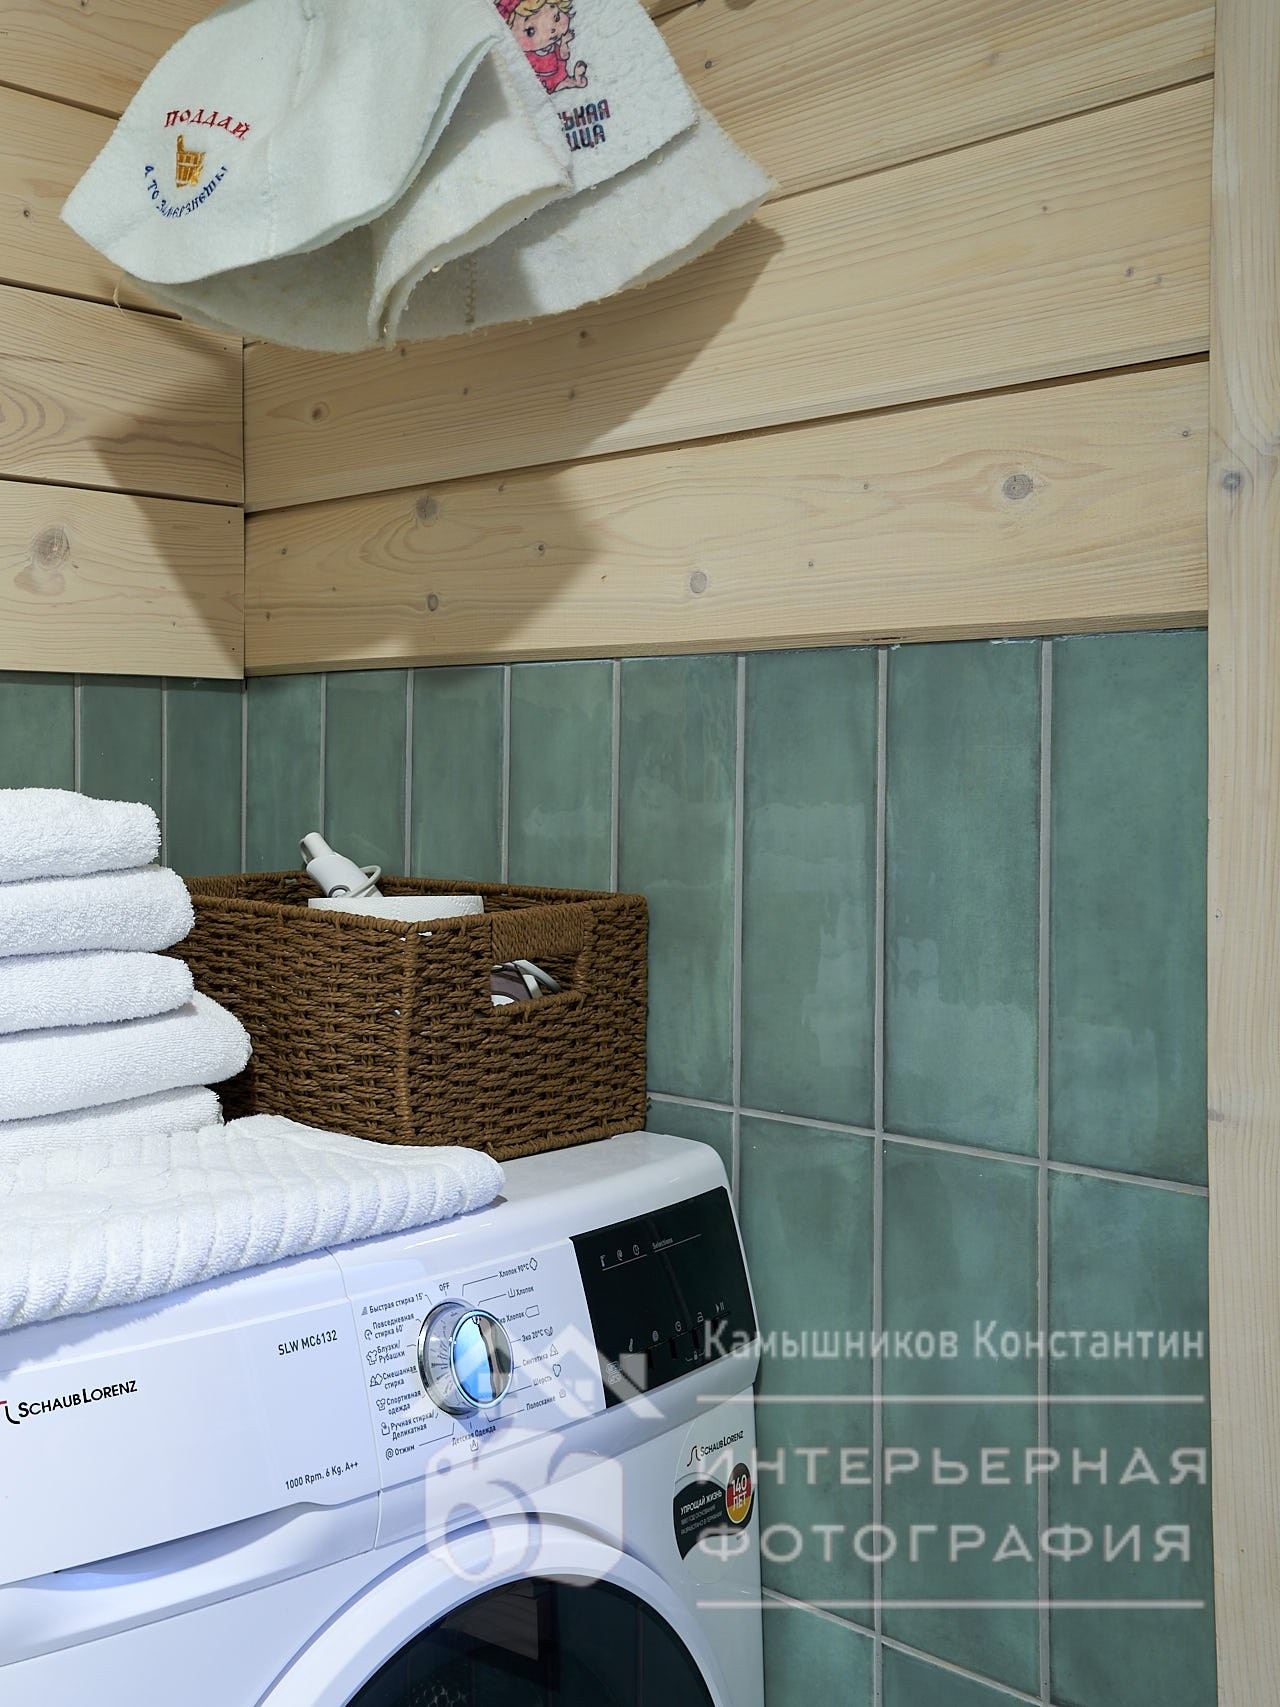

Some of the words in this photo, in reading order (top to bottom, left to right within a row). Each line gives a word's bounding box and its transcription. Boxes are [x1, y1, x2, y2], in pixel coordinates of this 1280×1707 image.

[557, 98, 611, 131] ЬНАЯ
[499, 1268, 517, 1278] Хлопок
[438, 1282, 450, 1292] OFF
[516, 1286, 534, 1296] Хлопок
[369, 1302, 395, 1313] Быстрая
[395, 1296, 415, 1307] стирка
[372, 1313, 415, 1330] Повседневная
[506, 1311, 525, 1322] Хлопок
[374, 1328, 395, 1339] стирка
[522, 1334, 532, 1342] Эко
[278, 1340, 300, 1356] SLW
[301, 1329, 338, 1350] MC6132
[378, 1350, 405, 1364] Рубашки
[382, 1365, 417, 1380] Смешанная
[384, 1378, 405, 1390] стирка
[386, 1390, 421, 1406] Спортивная
[526, 1395, 556, 1411] Полоскание
[388, 1403, 411, 1415] одежда
[390, 1417, 412, 1431] Ручная
[392, 1423, 427, 1442] Деликатная
[452, 1432, 475, 1447] Детская
[474, 1425, 497, 1438] Одежда
[394, 1444, 415, 1456] Отжим
[285, 1476, 304, 1490] 1000
[304, 1472, 325, 1485] Rpm.
[325, 1468, 331, 1478] 6
[331, 1465, 344, 1476] Kg.
[344, 1461, 359, 1472] A++
[731, 1474, 747, 1496] 140
[732, 1491, 747, 1511] ЛЕТ
